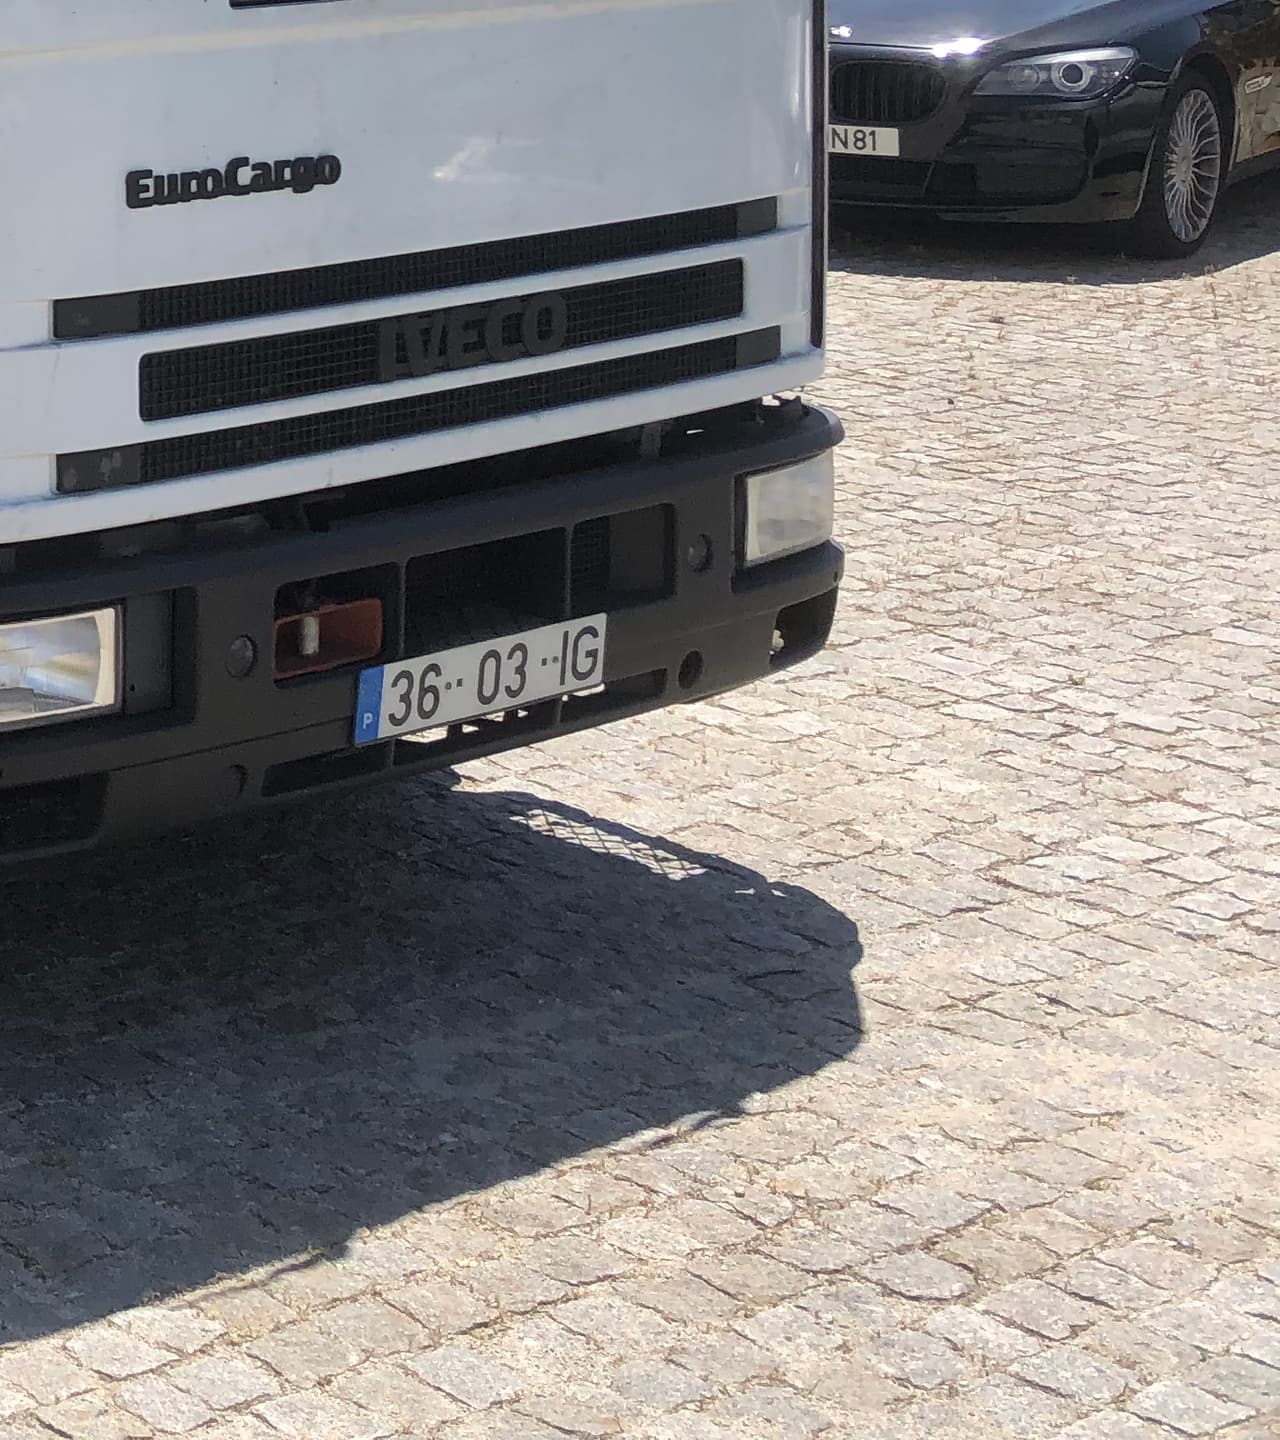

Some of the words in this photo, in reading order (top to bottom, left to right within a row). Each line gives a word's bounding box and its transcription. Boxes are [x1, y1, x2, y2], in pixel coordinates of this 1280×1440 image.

[125, 154, 342, 210] EuroCargo
[379, 292, 568, 382] IVECO
[362, 711, 374, 730] P
